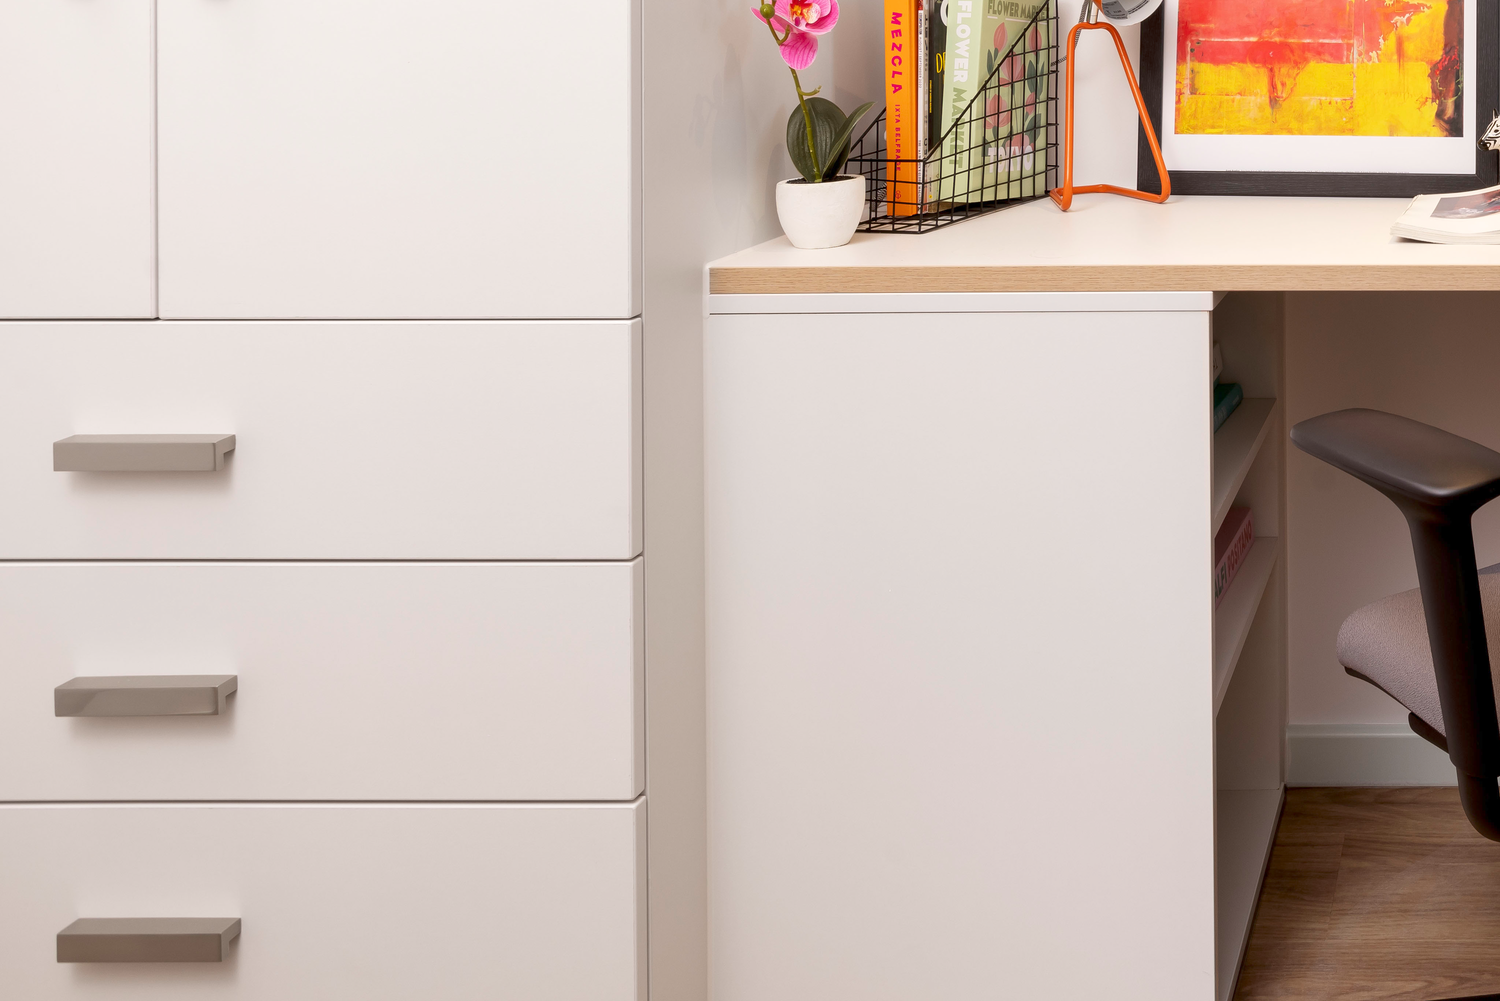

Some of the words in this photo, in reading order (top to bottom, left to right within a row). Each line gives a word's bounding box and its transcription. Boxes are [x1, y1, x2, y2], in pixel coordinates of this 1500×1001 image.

[953, 1, 973, 84] FLOWER
[988, 0, 1019, 17] FLOWER
[1020, 3, 1048, 19] MARE
[891, 12, 903, 94] MEZCLA
[949, 87, 967, 168] MARKET
[988, 145, 1034, 173] TOKYO
[1215, 561, 1227, 598] ALFI
[1227, 520, 1252, 577] POSITANO
